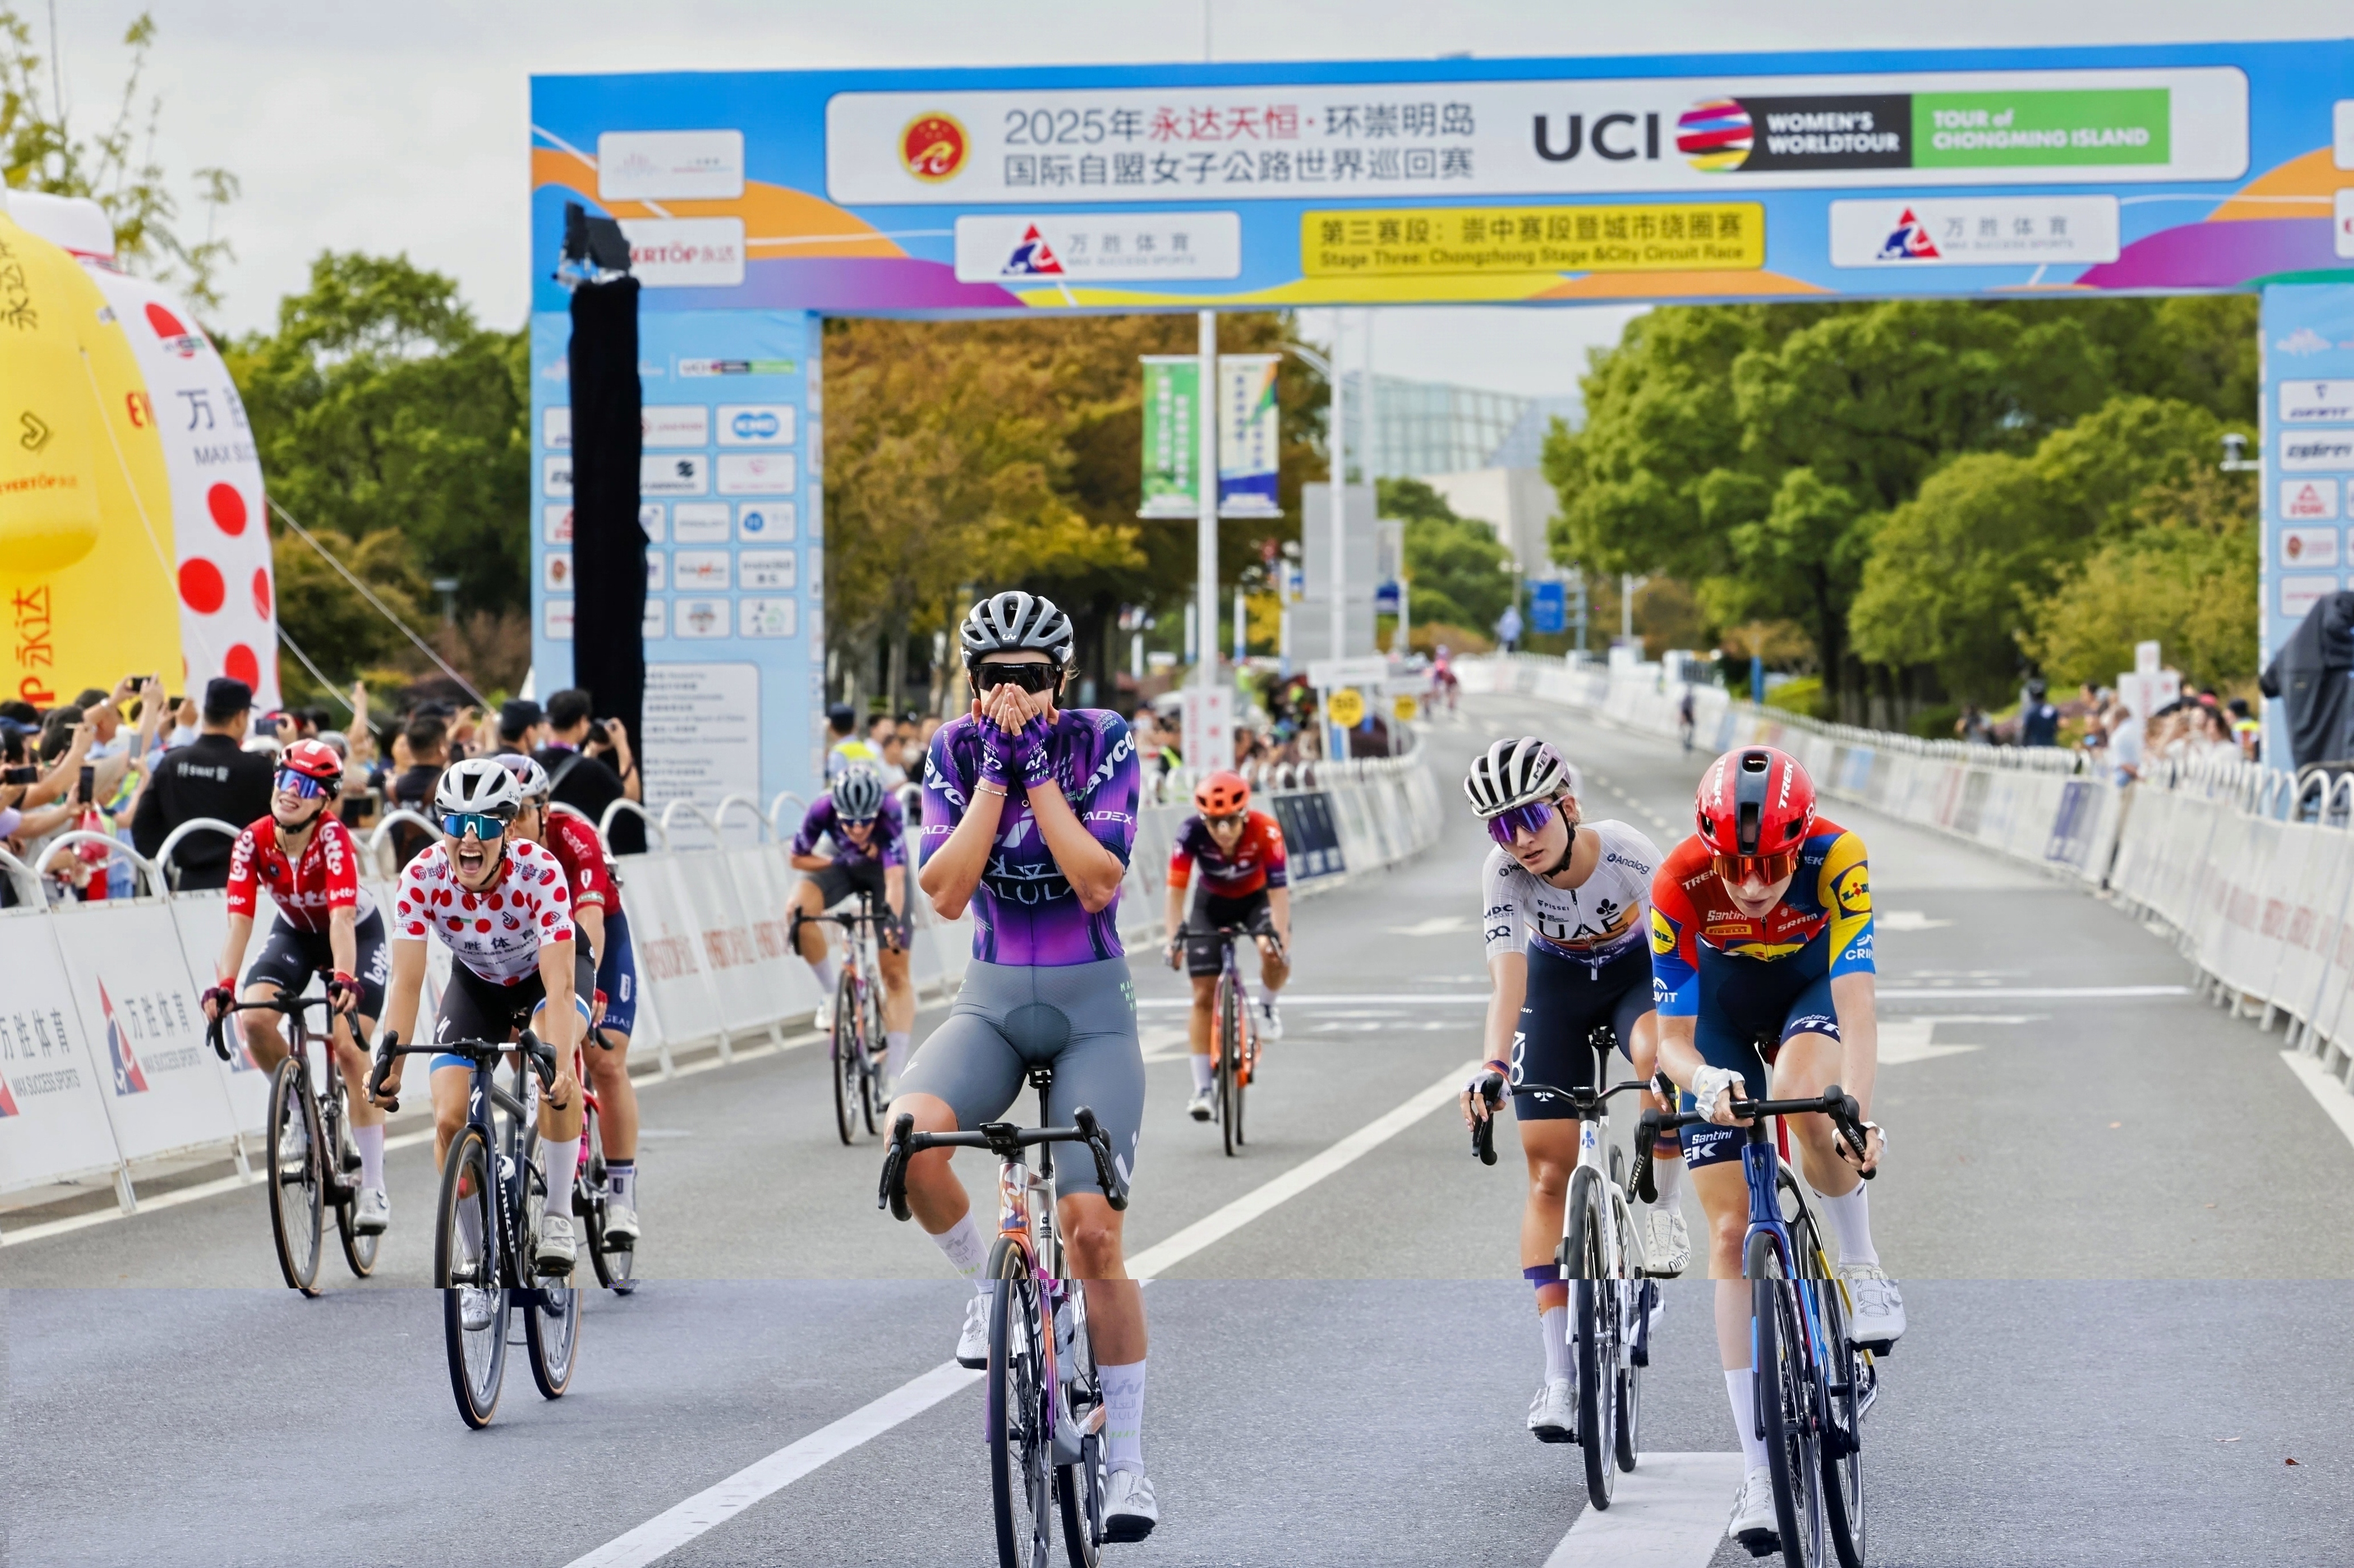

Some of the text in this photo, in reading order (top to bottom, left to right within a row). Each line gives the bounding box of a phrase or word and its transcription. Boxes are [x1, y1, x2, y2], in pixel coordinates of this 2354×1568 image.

[1004, 101, 1474, 144] 2025年永达天恒·环崇明岛
[1767, 111, 1874, 133] WOMEN'S
[1933, 108, 2014, 128] TOUR of
[1534, 114, 1659, 162] UCI
[1767, 132, 1900, 154] WORLDTOUR
[1932, 128, 2149, 150] CHONGMING ISLAND
[1004, 148, 1474, 186] 国际自盟女子公路世界巡回赛
[1321, 250, 1367, 269] Stage
[1541, 246, 1587, 266] Stage
[1644, 244, 1699, 261] Circuit
[1703, 243, 1742, 260] Race
[1087, 731, 1136, 795] ayco
[1533, 748, 1548, 780] MET
[1713, 758, 1726, 806] TREK
[1778, 759, 1794, 809] TREK
[1615, 855, 1650, 874] Analog
[1489, 912, 1515, 921] GROUP
[1545, 902, 1569, 911] PISSEI
[1707, 910, 1747, 922] Santin
[1538, 916, 1623, 939] UAE
[1777, 913, 1818, 932] SRAM
[439, 928, 536, 952] 万胜体育
[25, 1072, 57, 1096] SUCCESS
[54, 1068, 81, 1092] SPORTS
[1692, 1129, 1733, 1145] Santini
[1684, 1142, 1718, 1162] EK
[1095, 1147, 1112, 1185] DURA-ACE
[1628, 1154, 1645, 1192] SRAM
[1102, 1378, 1144, 1396] Liv
[1107, 1410, 1140, 1420] ALULA
[1110, 1429, 1137, 1439] MAAP
